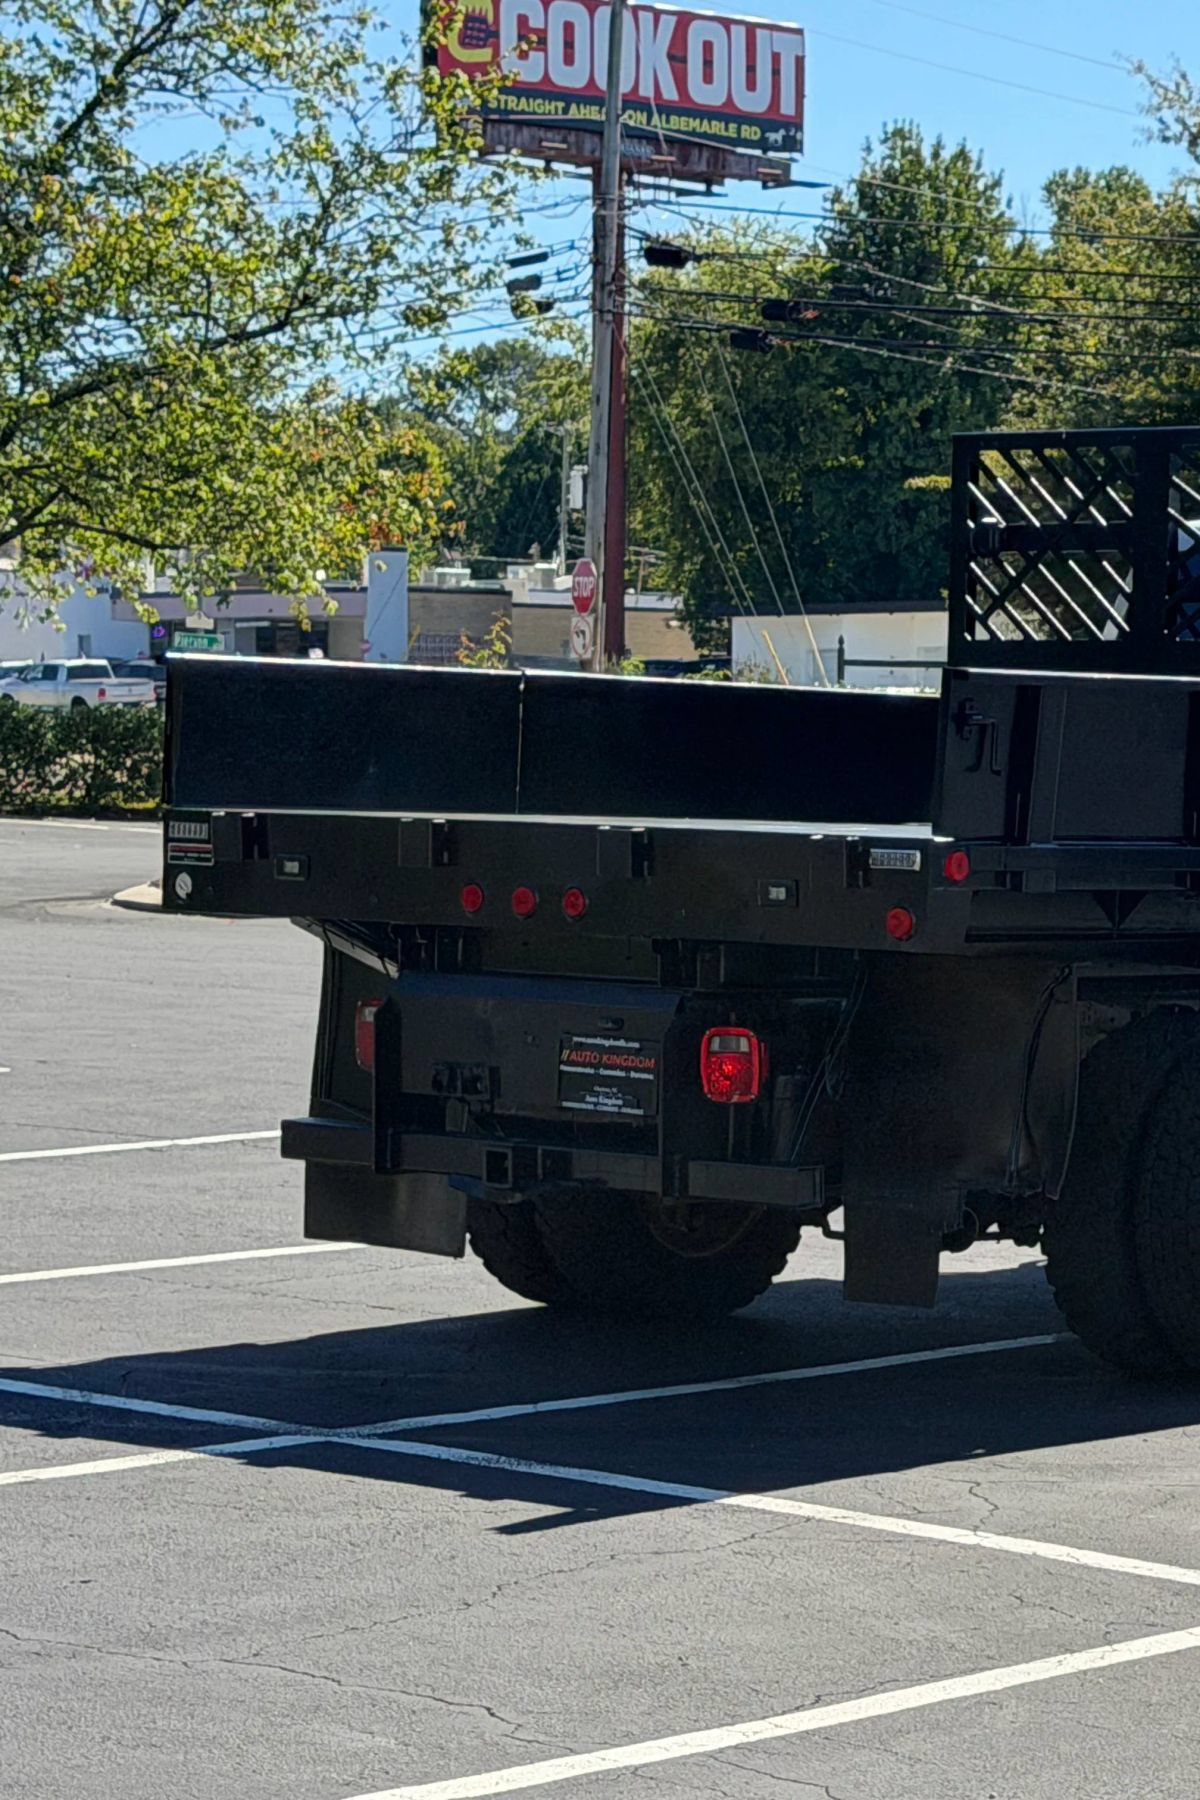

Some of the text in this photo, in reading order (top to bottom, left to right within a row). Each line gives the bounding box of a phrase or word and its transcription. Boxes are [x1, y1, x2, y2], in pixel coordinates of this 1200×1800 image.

[500, 0, 804, 116] COOK OUT
[487, 95, 762, 141] STRAIGHT AHE ON ALBEMARLE RD
[573, 576, 594, 597] STOP
[569, 1050, 656, 1068] AUTO KINGDOM
